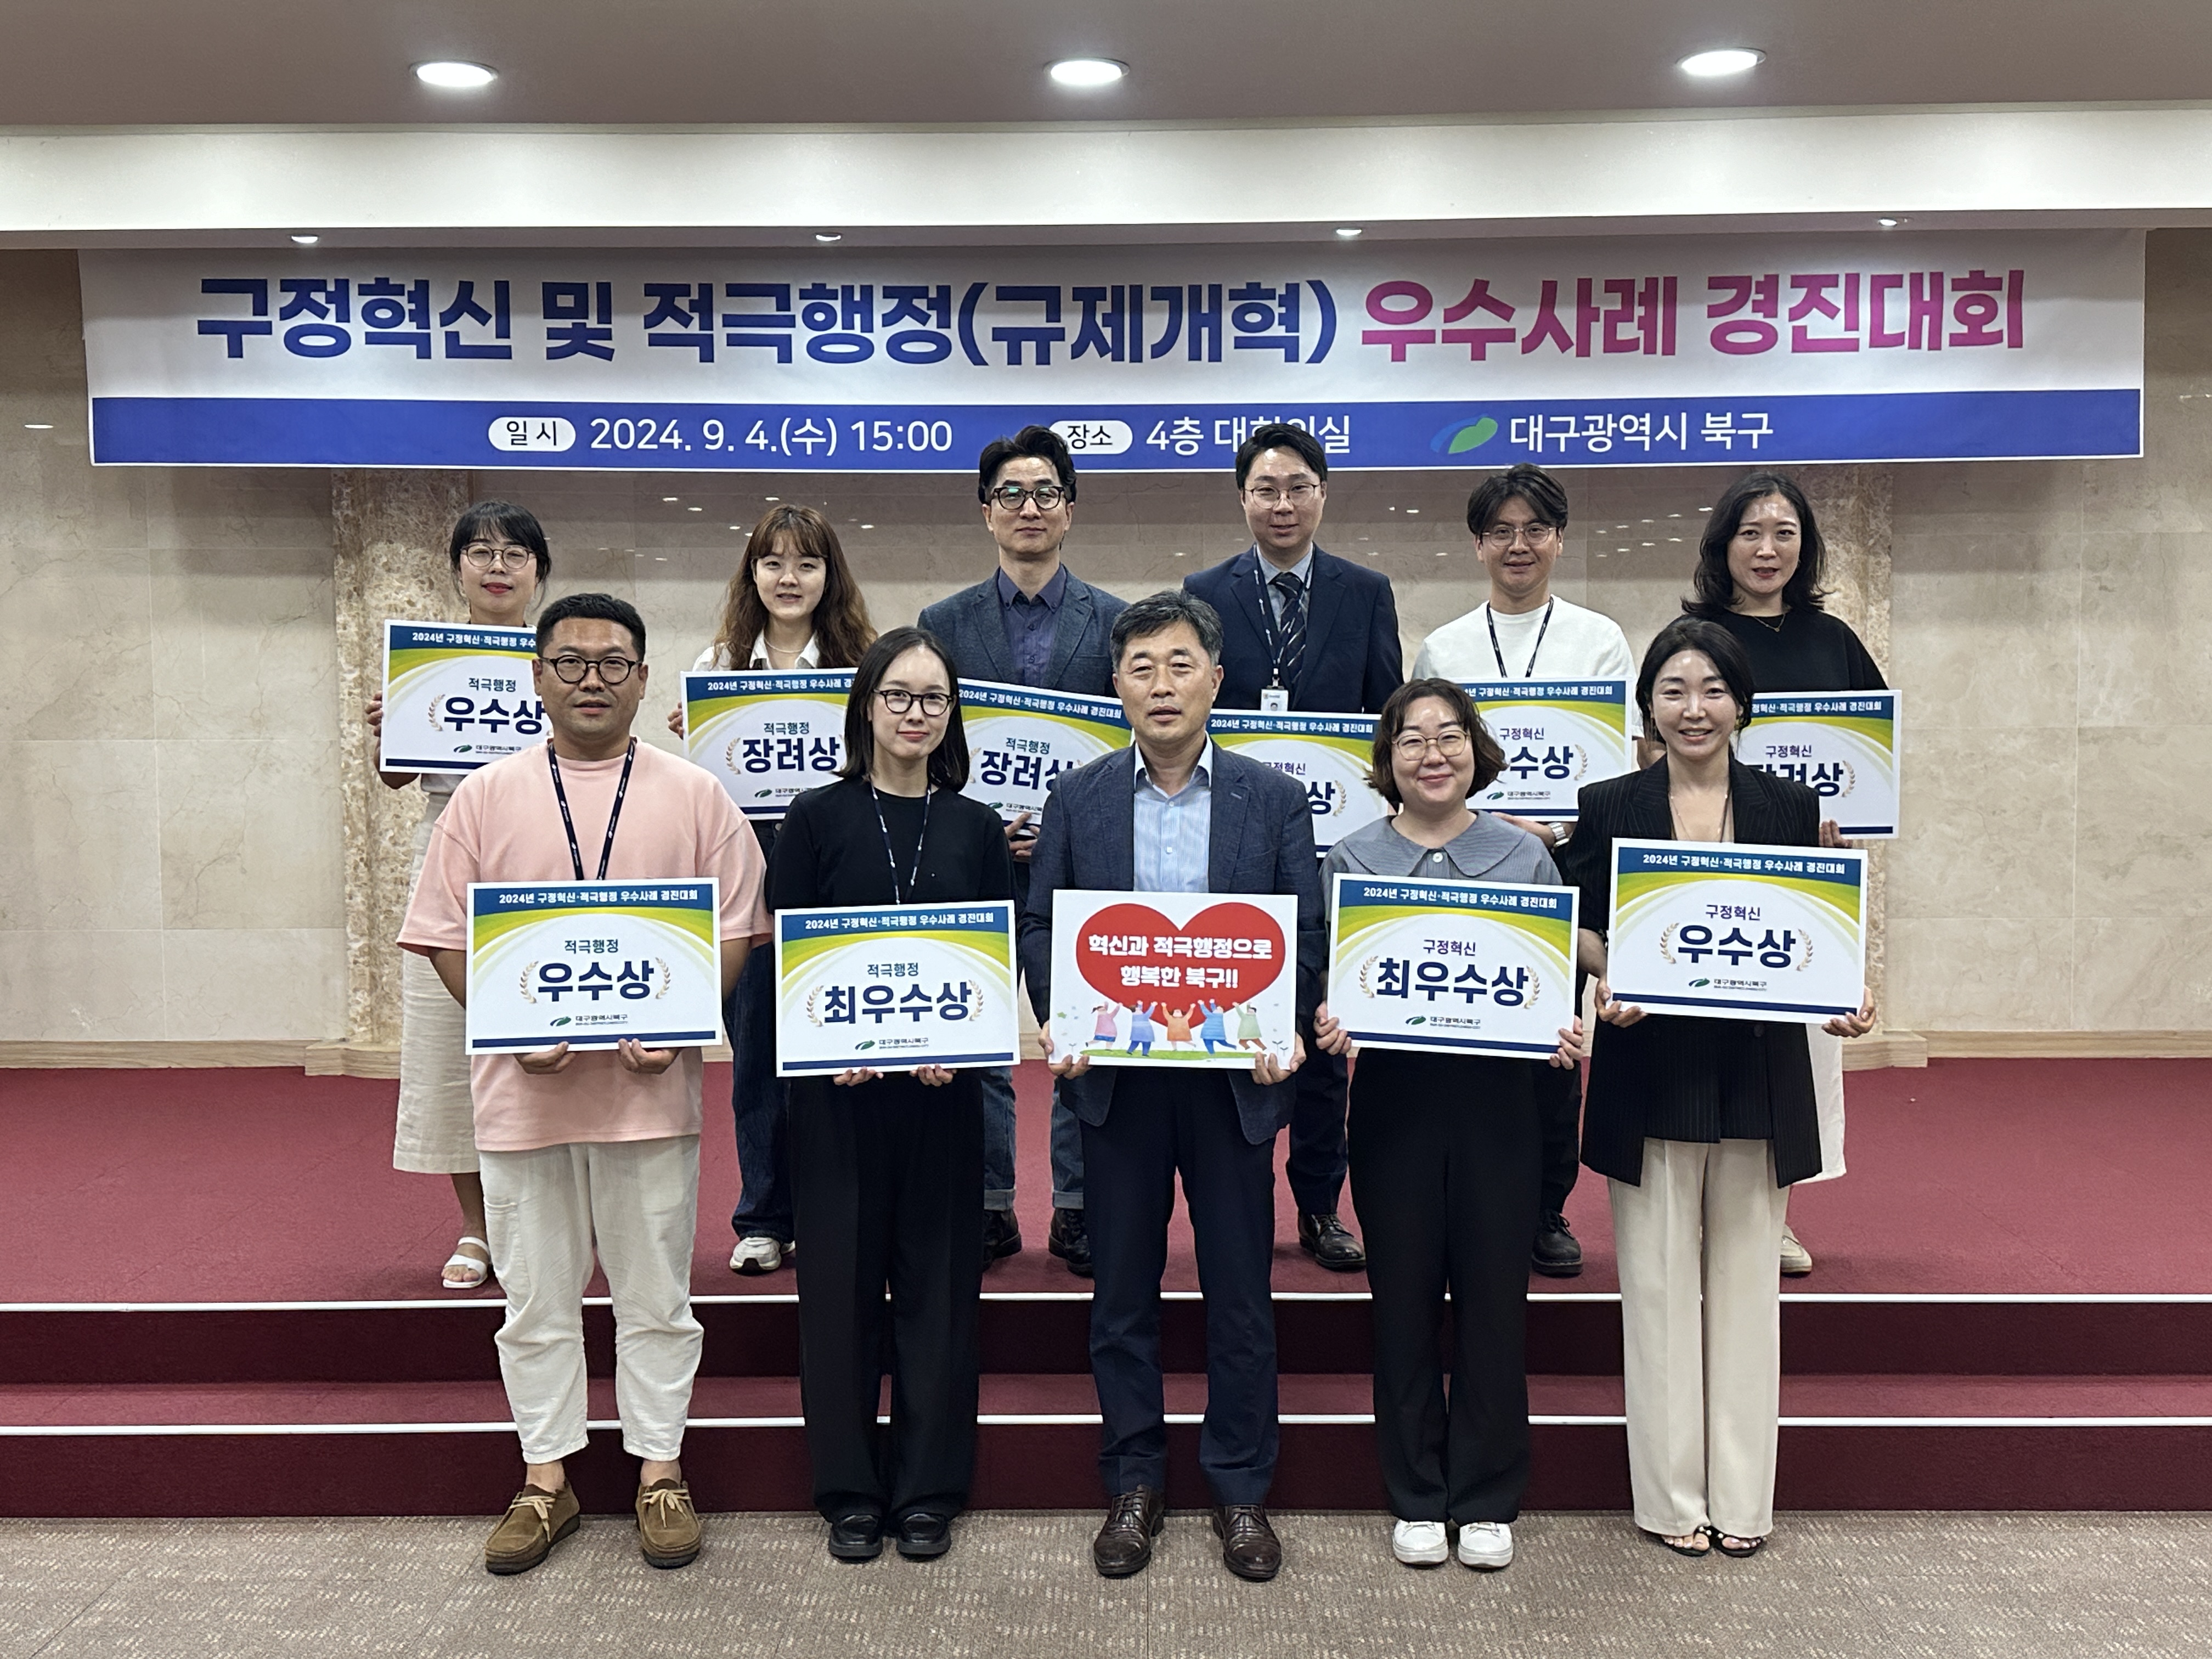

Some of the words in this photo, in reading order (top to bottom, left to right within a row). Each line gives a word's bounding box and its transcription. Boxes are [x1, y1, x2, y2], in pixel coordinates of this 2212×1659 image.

[197, 277, 514, 360] 구정혁신
[542, 281, 615, 362] 및
[644, 279, 1337, 366] 적극행정(규제개혁)
[1361, 275, 1678, 362] 우수사례
[1707, 268, 2025, 356] 경진대회
[590, 418, 691, 451] 2024.
[704, 419, 735, 452] 9.
[851, 420, 952, 453] 15:00
[1068, 424, 1113, 449] 장소
[1146, 416, 1204, 456] 4층
[1509, 413, 1687, 454] 대구광역시
[1701, 411, 1774, 450] 북구
[413, 632, 444, 644] 2024년
[469, 677, 517, 693] 적극행정
[707, 680, 738, 691] 2024년
[810, 678, 842, 689] 우수사례
[1547, 686, 1578, 696] 우수사례
[958, 689, 988, 701] 2024년
[1057, 702, 1088, 715] 우수사례
[1814, 702, 1847, 713] 우수사례
[444, 696, 546, 735] 우수상
[764, 721, 810, 736] 적극행정
[1211, 719, 1240, 729] 2024년
[1309, 722, 1340, 733] 우수사례
[1499, 727, 1545, 741] 구정혁신
[742, 736, 841, 774] 장려상
[1005, 737, 1051, 755] 적극행정
[1765, 744, 1812, 759] 구정혁신
[1509, 746, 1574, 780] 수상
[1643, 854, 1678, 866] 2024년
[1764, 859, 1803, 873] 우수사례
[499, 893, 535, 905] 2024년
[620, 890, 658, 902] 우수사례
[1363, 887, 1398, 900] 2024년
[1480, 894, 1517, 907] 우수사례
[805, 918, 839, 929] 2024년
[919, 914, 956, 926] 우수사례
[1705, 904, 1761, 921] 구정혁신
[564, 938, 619, 955] 적극행정
[1088, 934, 1149, 957] 혁신과
[1153, 935, 1273, 960] 적극행정으로
[1423, 939, 1477, 956] 구정혁신
[1677, 924, 1797, 969] 우수상
[867, 962, 919, 978] 적극행정
[1120, 966, 1181, 987] 행복한
[1186, 967, 1239, 989] 북구!!
[538, 960, 654, 1002] 우수상
[1376, 957, 1530, 1007] 최우수상
[824, 981, 972, 1024] 최우수상
